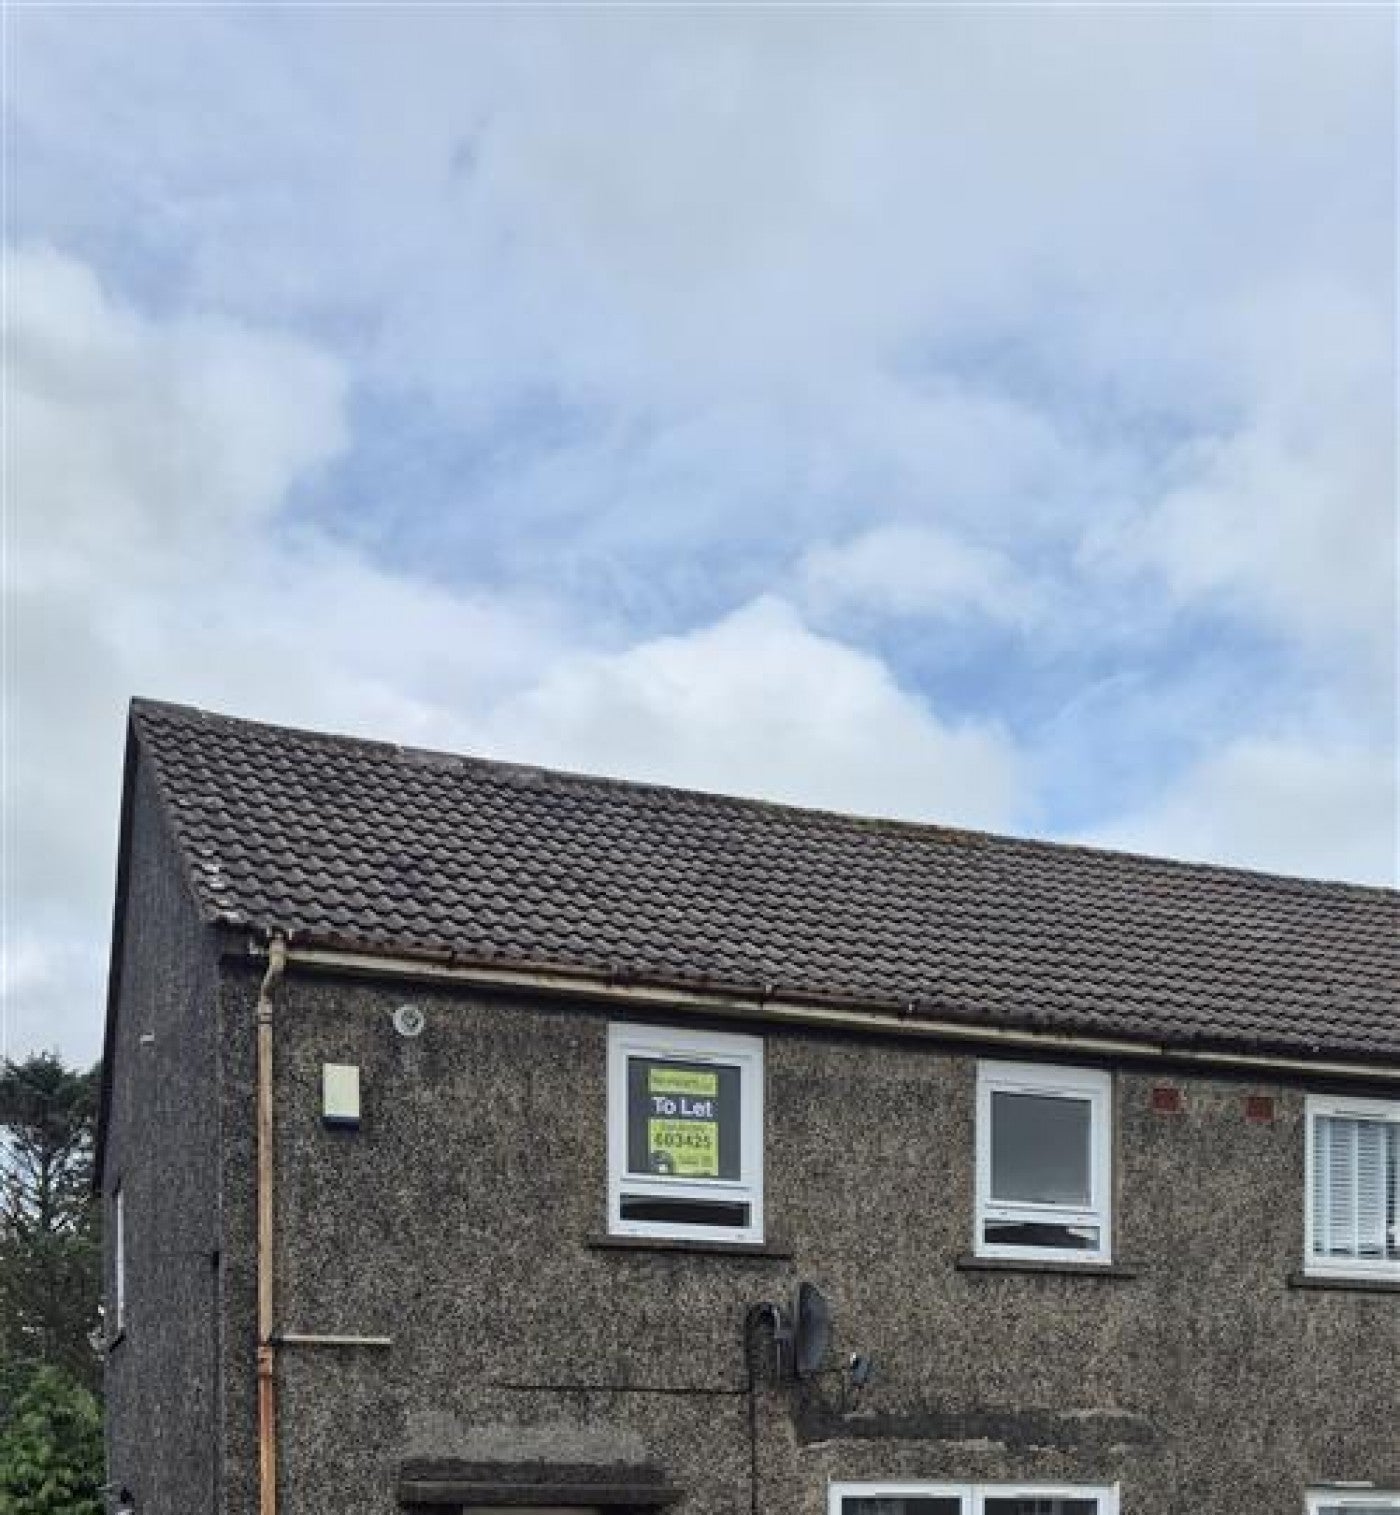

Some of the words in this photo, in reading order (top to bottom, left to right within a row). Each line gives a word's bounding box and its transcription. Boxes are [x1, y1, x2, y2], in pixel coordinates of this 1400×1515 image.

[652, 1097, 676, 1115] To
[681, 1099, 713, 1118] Let
[653, 1132, 712, 1150] 603425
